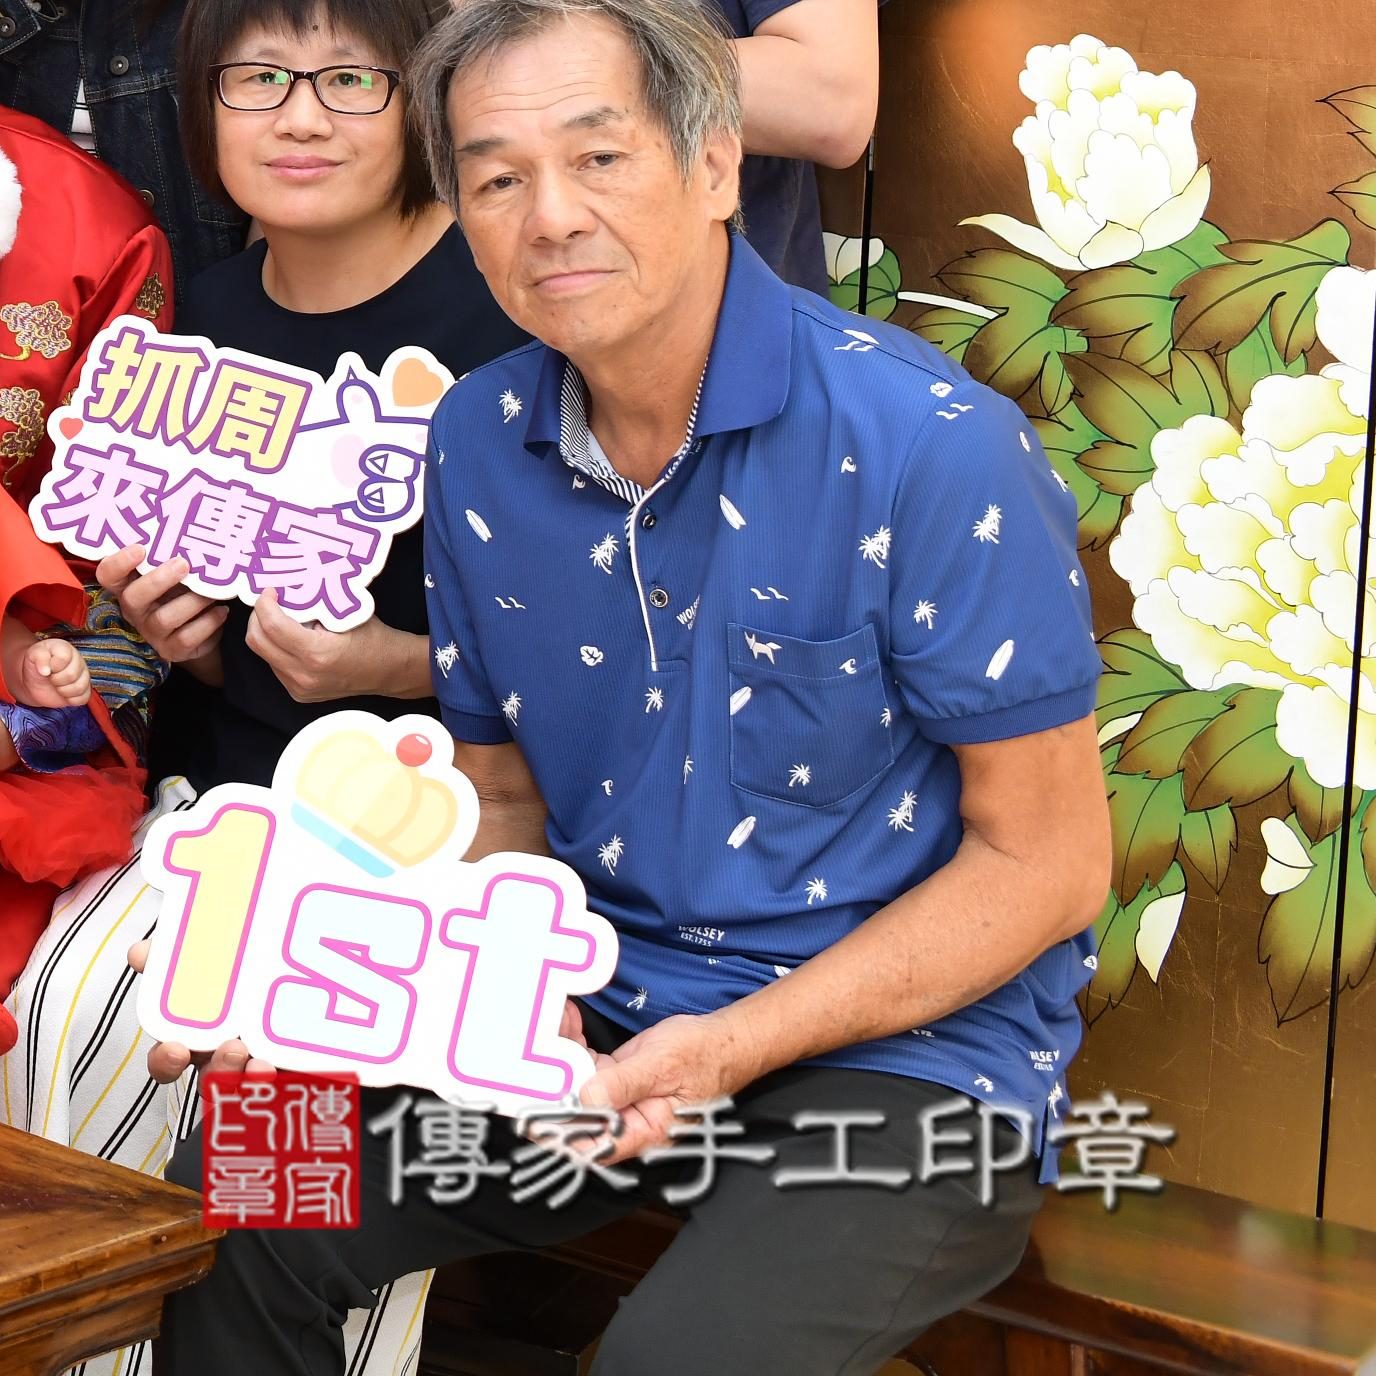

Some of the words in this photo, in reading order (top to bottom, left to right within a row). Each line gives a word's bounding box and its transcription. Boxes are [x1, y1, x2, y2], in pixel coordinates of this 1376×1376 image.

[84, 327, 312, 472] 抓周
[42, 444, 381, 619] 來傳家
[159, 802, 597, 1101] 1st
[678, 925, 725, 941] WOLSEY
